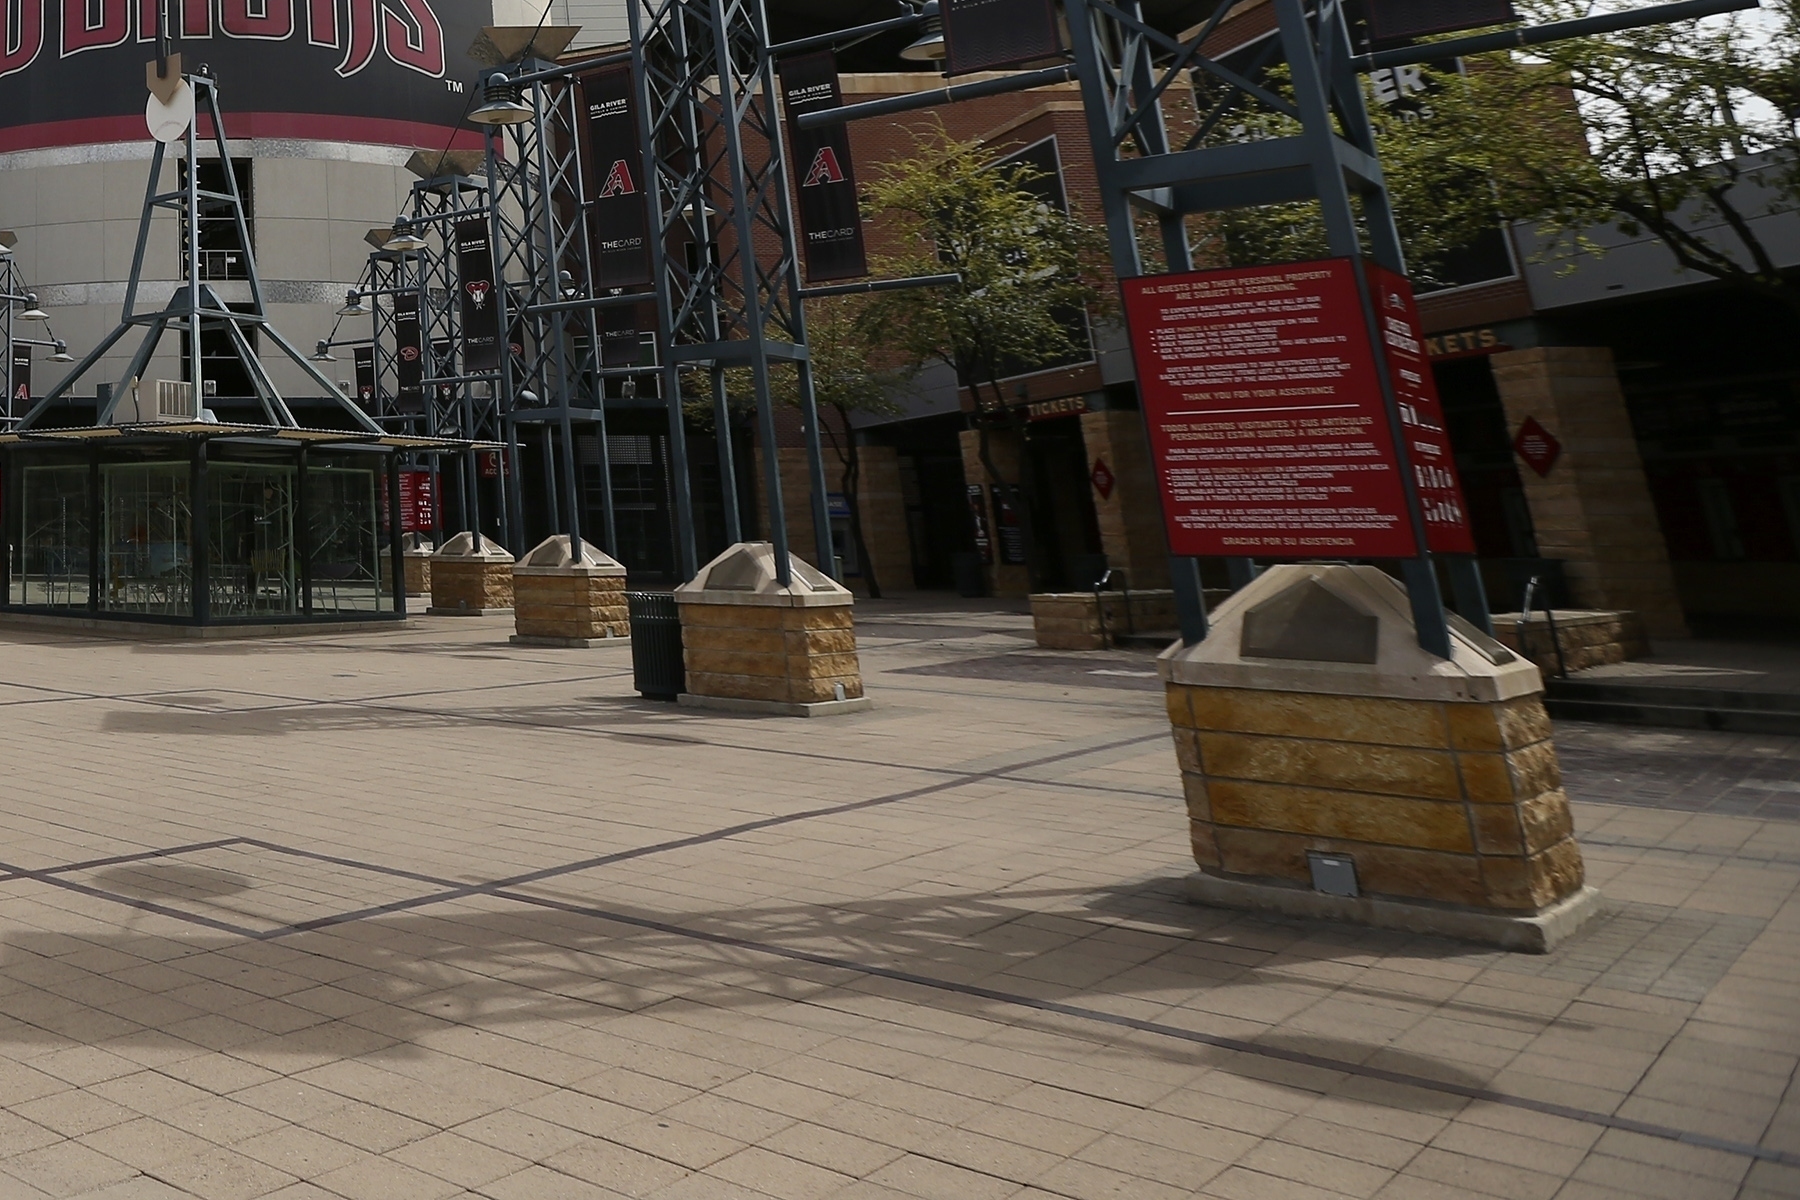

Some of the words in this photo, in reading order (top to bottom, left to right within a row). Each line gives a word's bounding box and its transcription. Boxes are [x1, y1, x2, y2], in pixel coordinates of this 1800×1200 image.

[788, 88, 807, 97] GILA
[807, 83, 831, 93] RIVER
[590, 103, 605, 111] GILA
[606, 99, 626, 108] RIVER
[1141, 286, 1156, 294] ALL
[1157, 283, 1189, 293] GUESTS
[1191, 281, 1210, 289] AND
[1212, 279, 1236, 288] THEIR
[1238, 274, 1283, 285] PERSONAL
[1285, 270, 1332, 281] PROPERTY
[1175, 291, 1192, 299] ARE
[1193, 288, 1230, 298] SUBJECT
[1245, 282, 1298, 293] SCREENING.
[1423, 329, 1497, 356] KETS
[1182, 392, 1211, 400] THANK
[1213, 391, 1231, 399] YOU
[1233, 390, 1250, 398] FOR
[1251, 388, 1276, 397] YOUR
[1278, 386, 1335, 396] ASSISTANCE
[1027, 396, 1084, 416] TICKETS
[1222, 537, 1260, 545] GRACIAS
[1263, 537, 1281, 545] POR
[1298, 537, 1355, 545] ASISTENCIA
